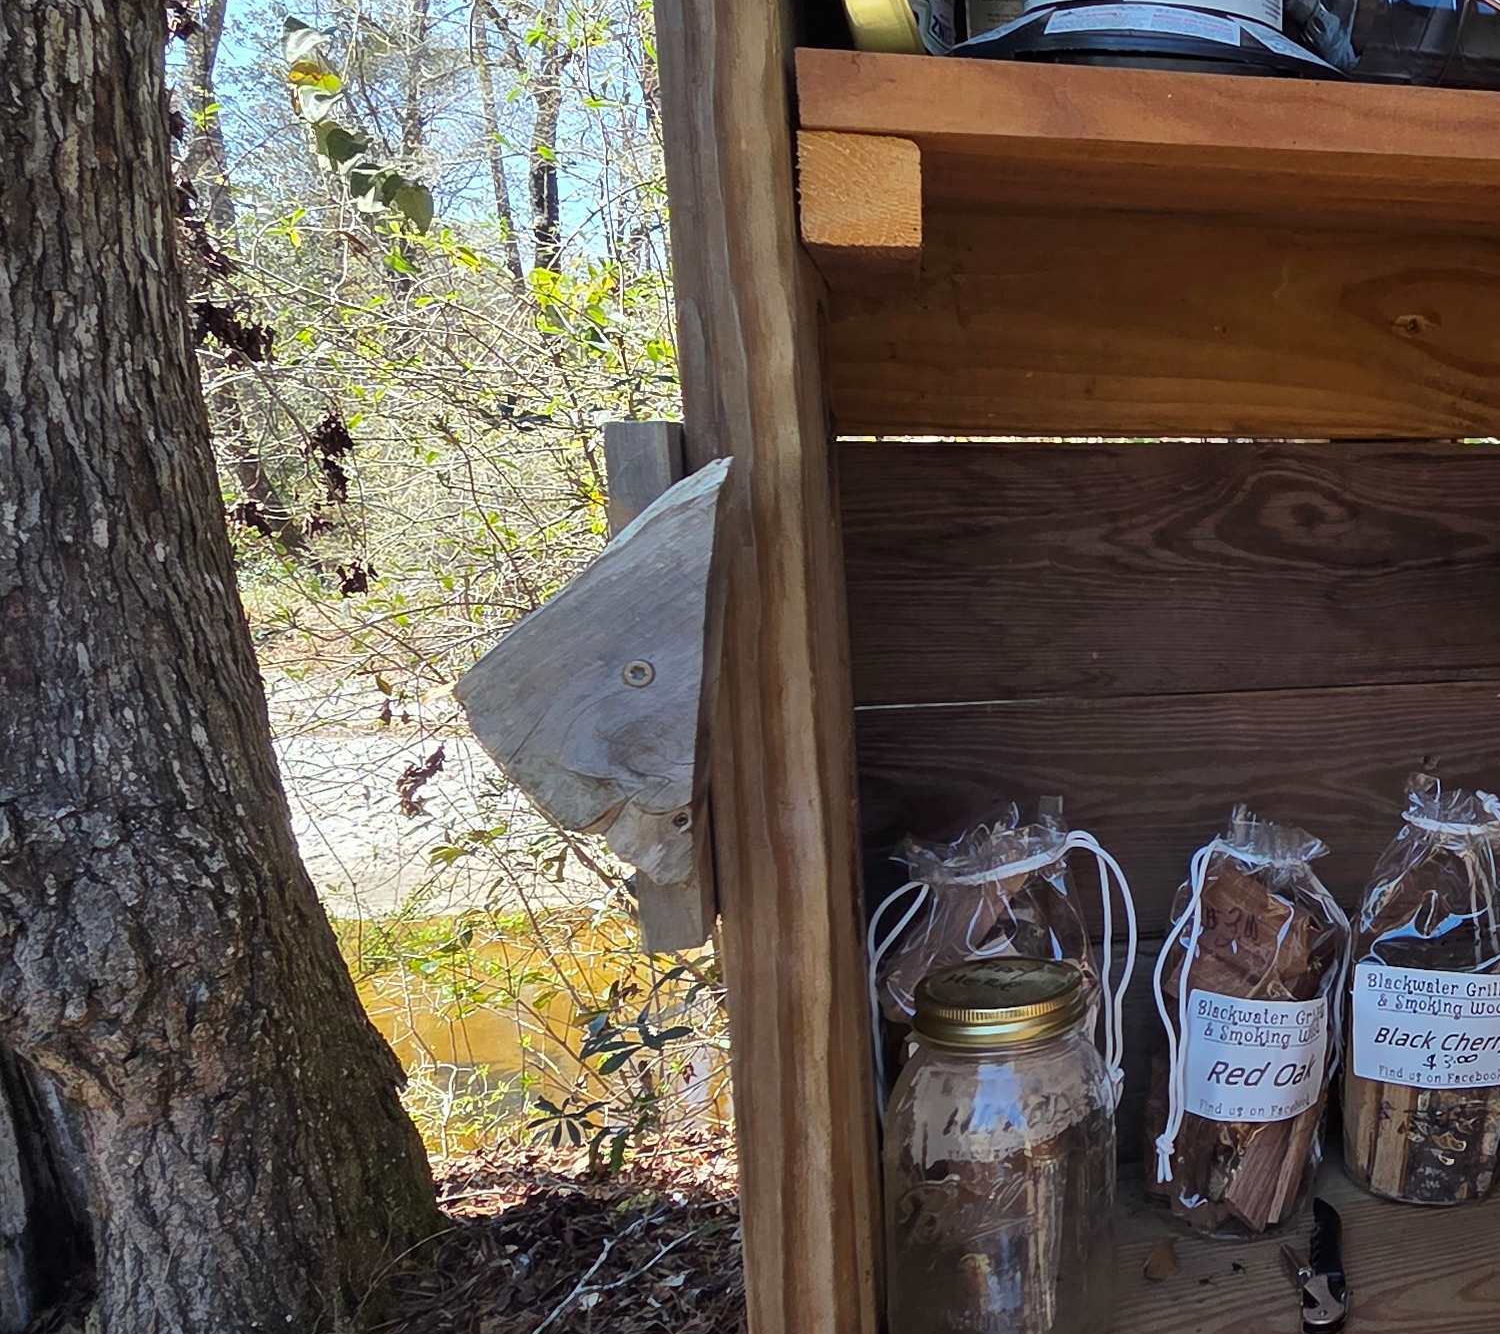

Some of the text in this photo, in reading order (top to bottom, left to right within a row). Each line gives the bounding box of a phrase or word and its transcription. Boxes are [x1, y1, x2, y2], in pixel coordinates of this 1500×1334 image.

[1367, 972, 1460, 996] Blackwater
[1197, 998, 1289, 1026] Blackwater
[1377, 993, 1389, 1008] &
[1395, 994, 1464, 1020] Smoking
[1203, 1022, 1214, 1037] &
[1219, 1024, 1292, 1050] Smoking
[1374, 1026, 1437, 1050] Black
[1207, 1053, 1316, 1087] Red Oak
[1378, 1064, 1403, 1079] Find
[1408, 1071, 1422, 1083] us
[1427, 1072, 1441, 1083] on
[1421, 1053, 1437, 1070] $
[1200, 1098, 1223, 1114] Find
[1228, 1105, 1244, 1117] us
[1249, 1105, 1265, 1117] on
